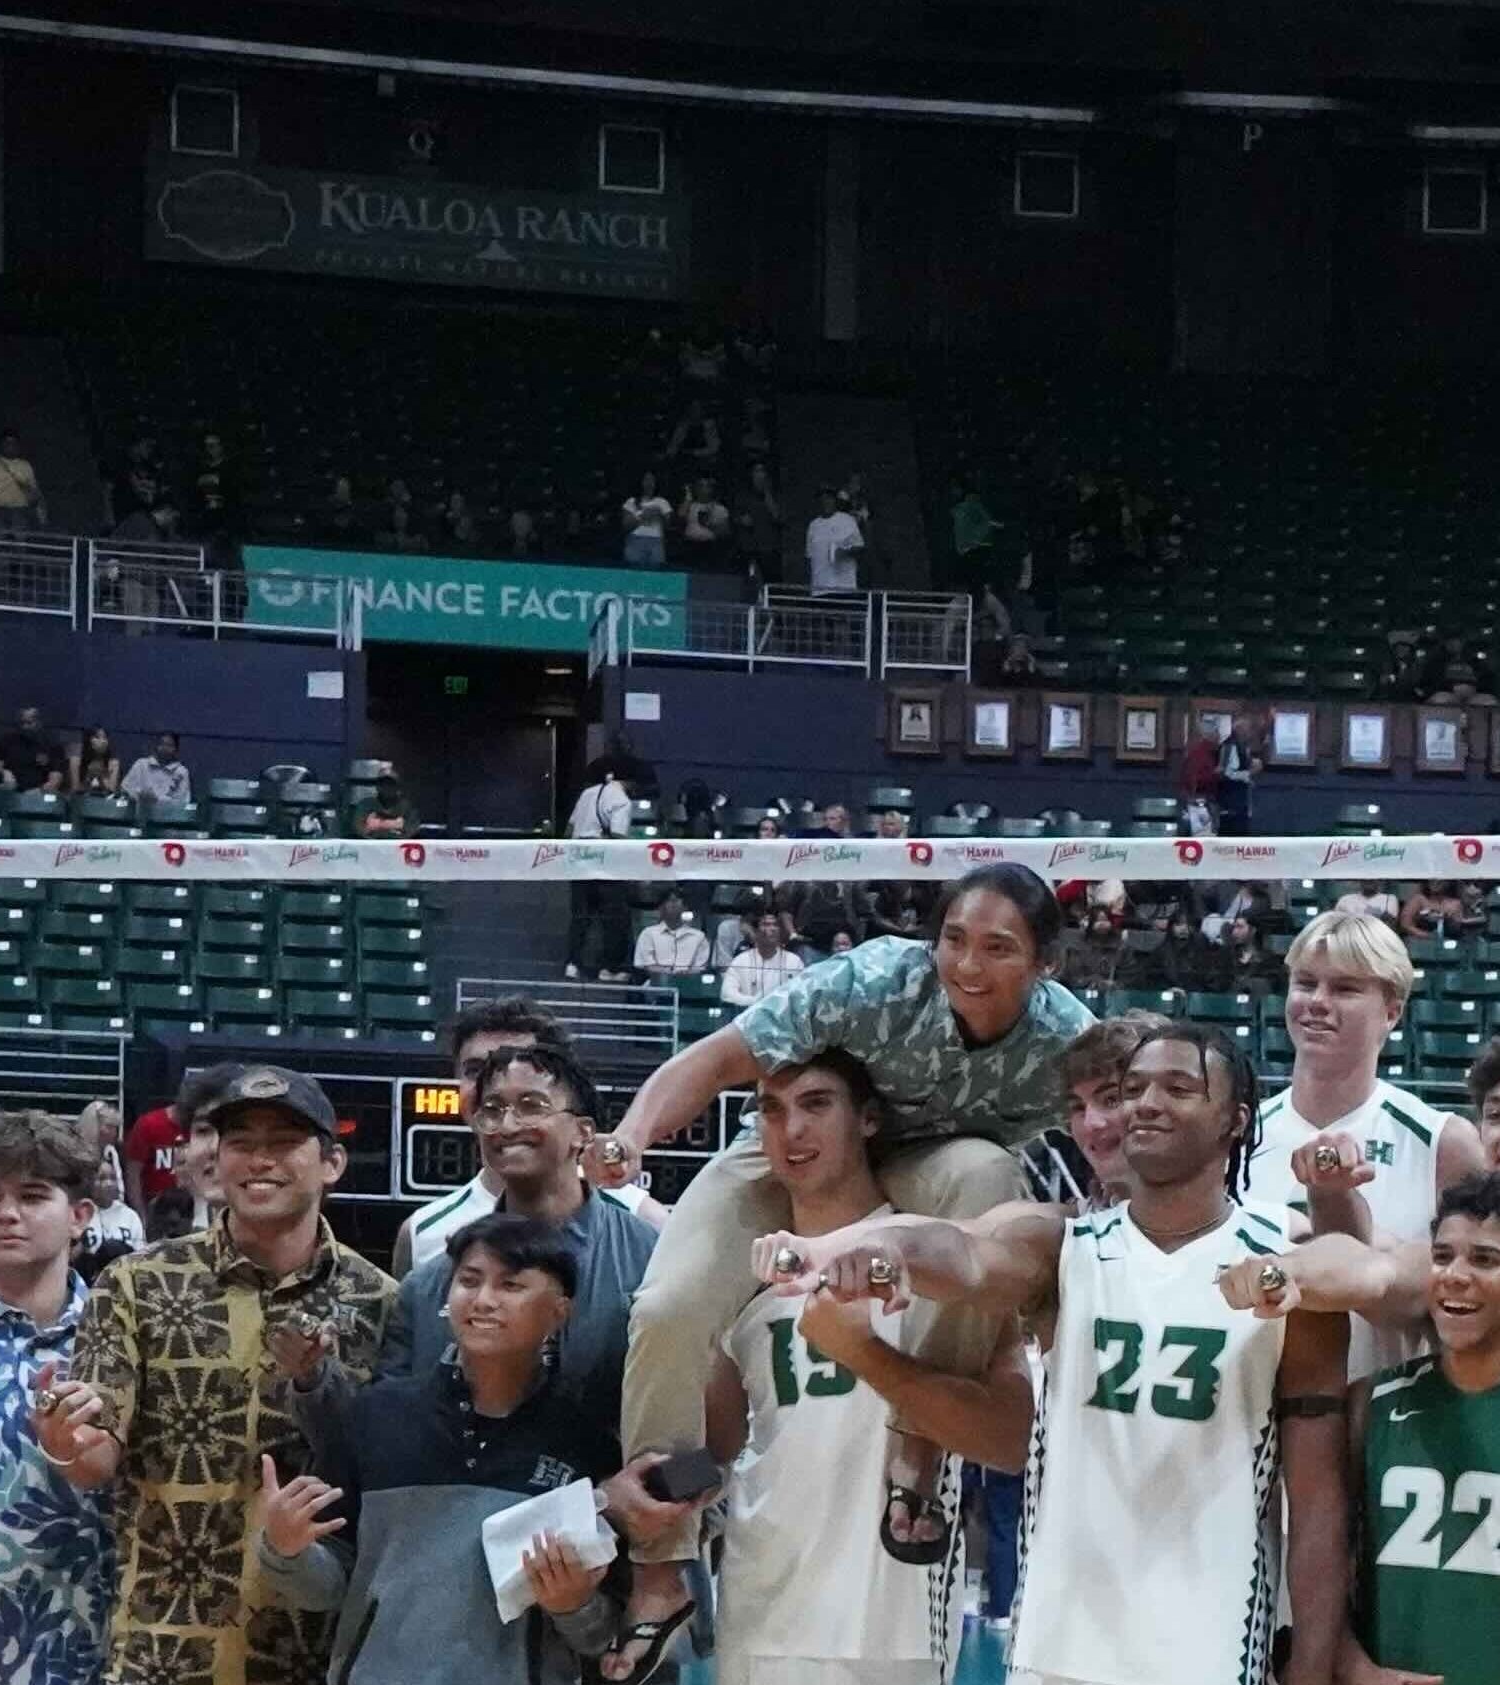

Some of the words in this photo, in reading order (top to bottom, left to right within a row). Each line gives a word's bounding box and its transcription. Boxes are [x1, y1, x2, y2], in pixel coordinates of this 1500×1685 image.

[319, 181, 505, 239] KUALOA
[517, 204, 670, 250] RANCH
[312, 577, 485, 616] FNANCE
[499, 586, 671, 627] FACTORS
[84, 1227, 132, 1248] GP
[1088, 1317, 1228, 1421] 23
